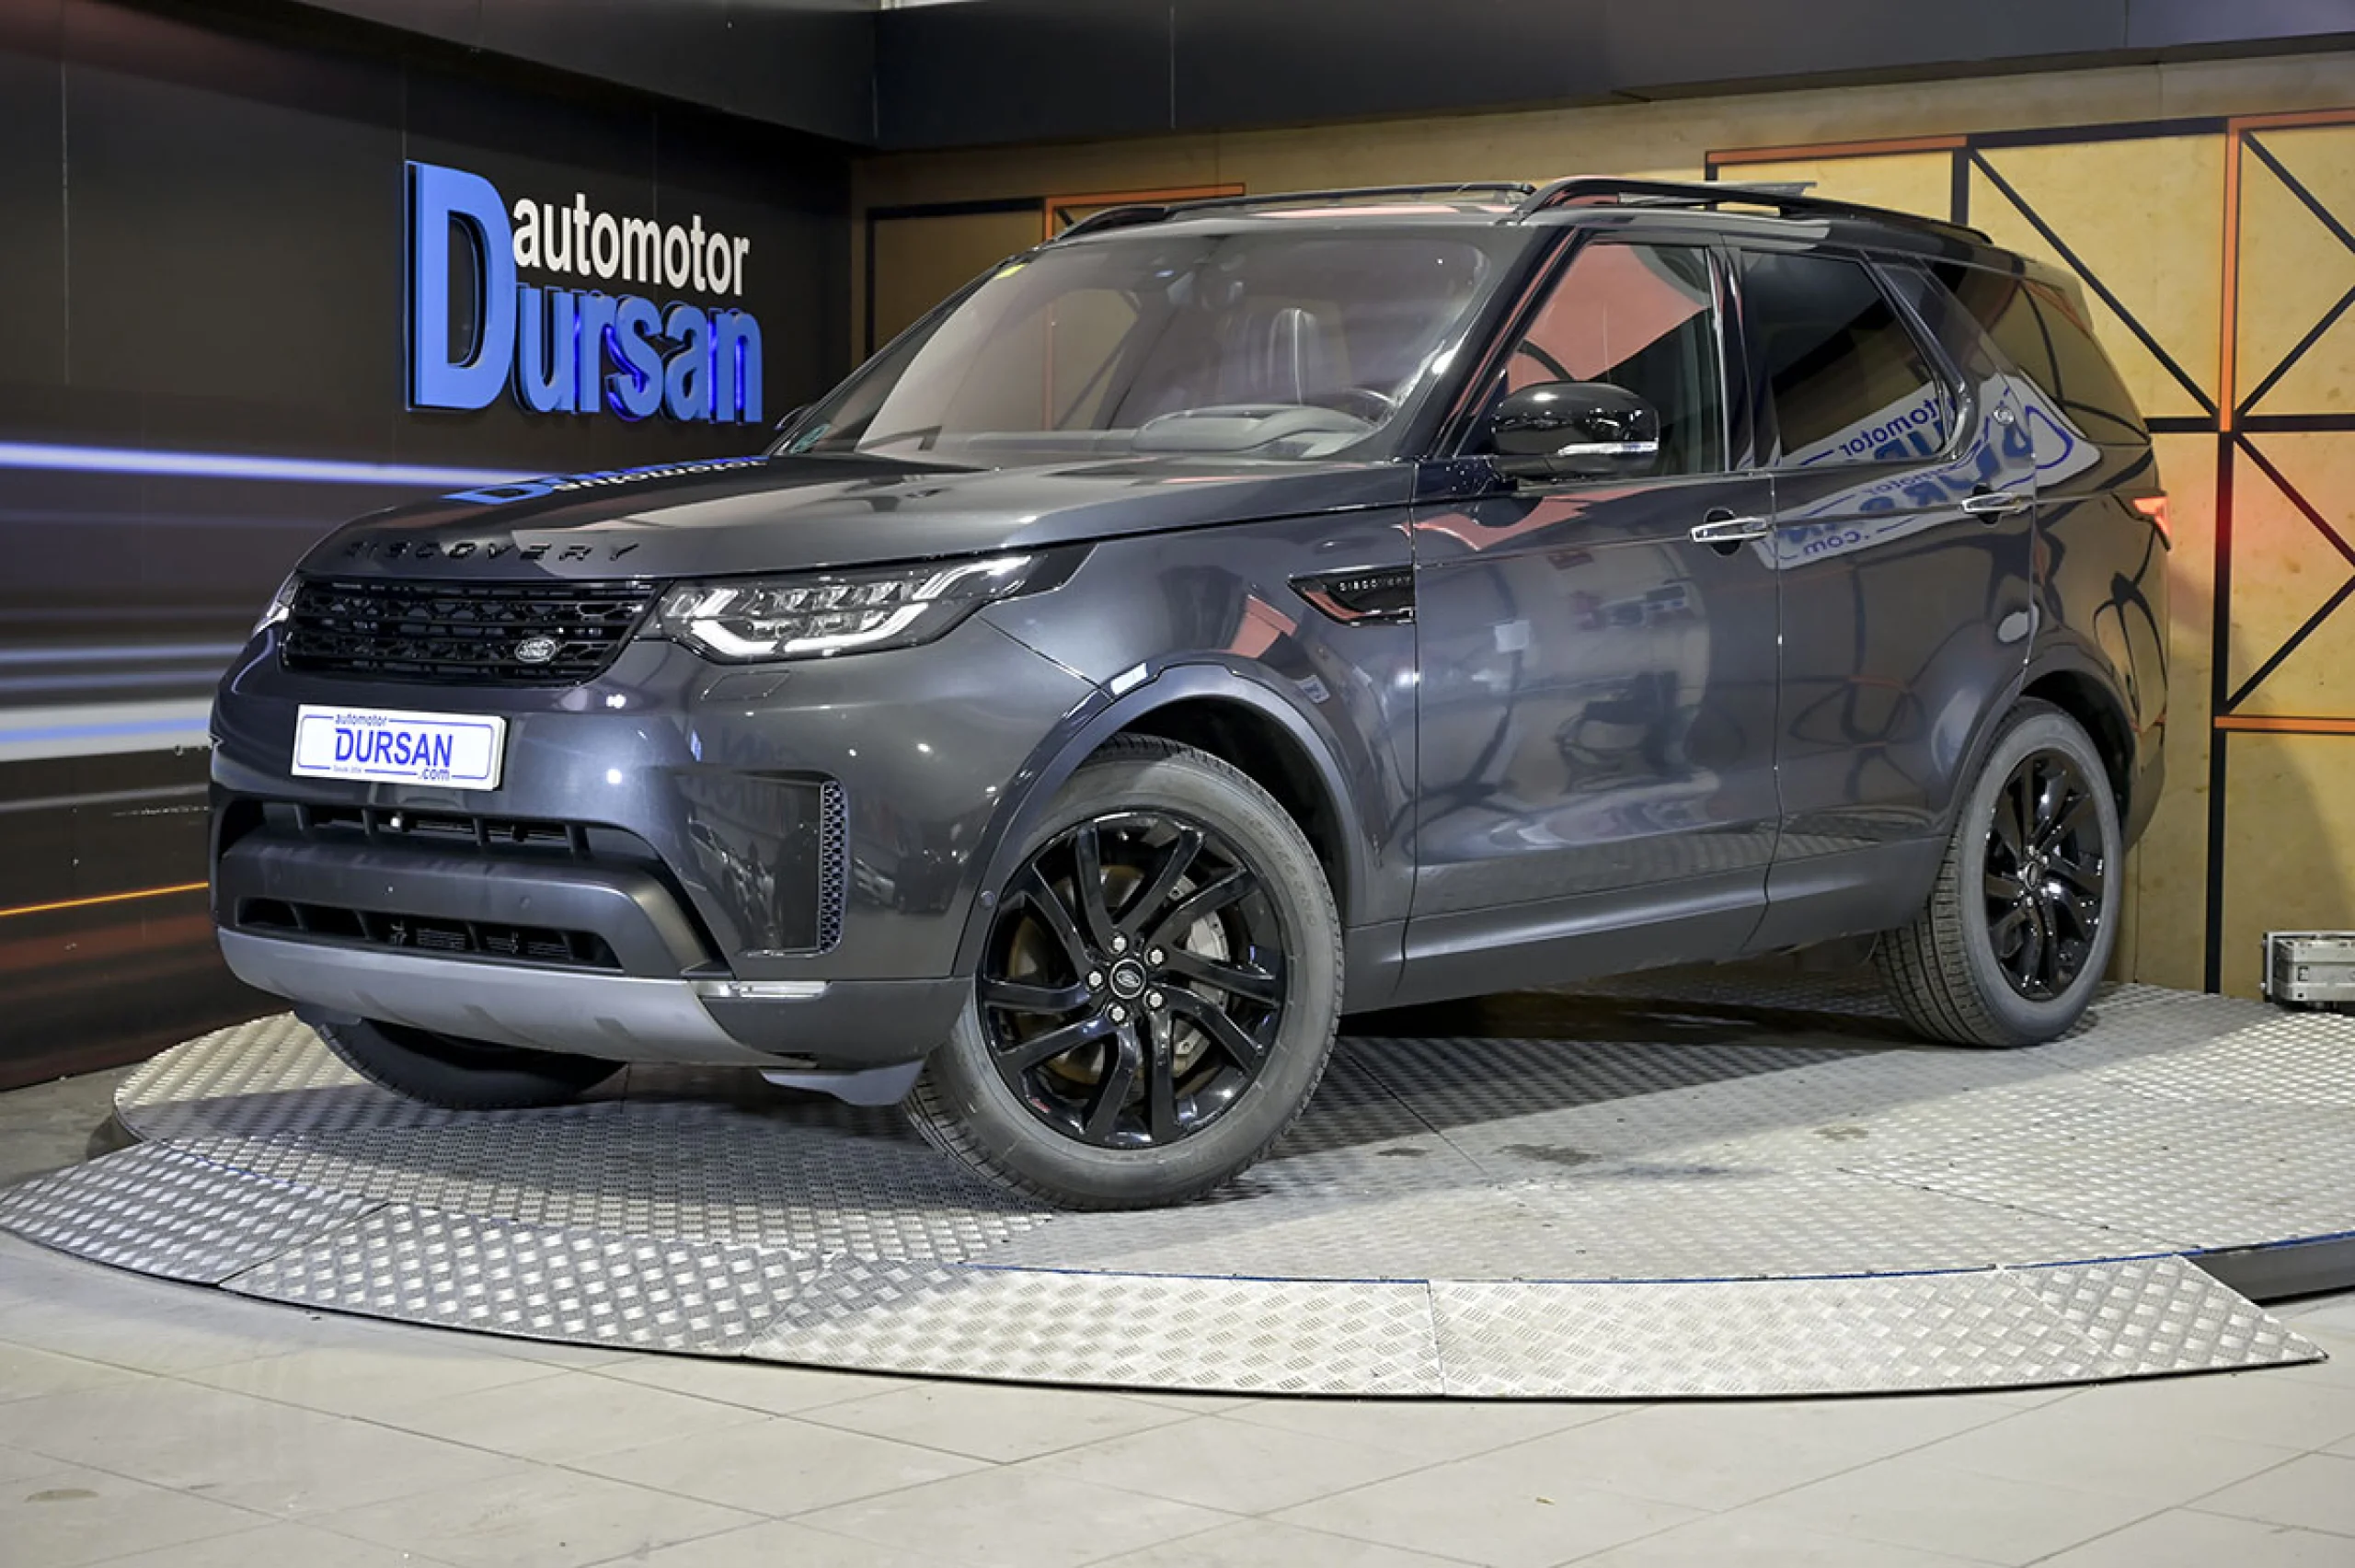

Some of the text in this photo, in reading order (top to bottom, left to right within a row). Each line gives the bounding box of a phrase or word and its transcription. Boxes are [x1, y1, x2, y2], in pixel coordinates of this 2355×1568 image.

[513, 192, 750, 296] automotor
[405, 159, 764, 424] Dursan
[335, 727, 454, 768] DURSAN
[418, 768, 451, 781] .com
